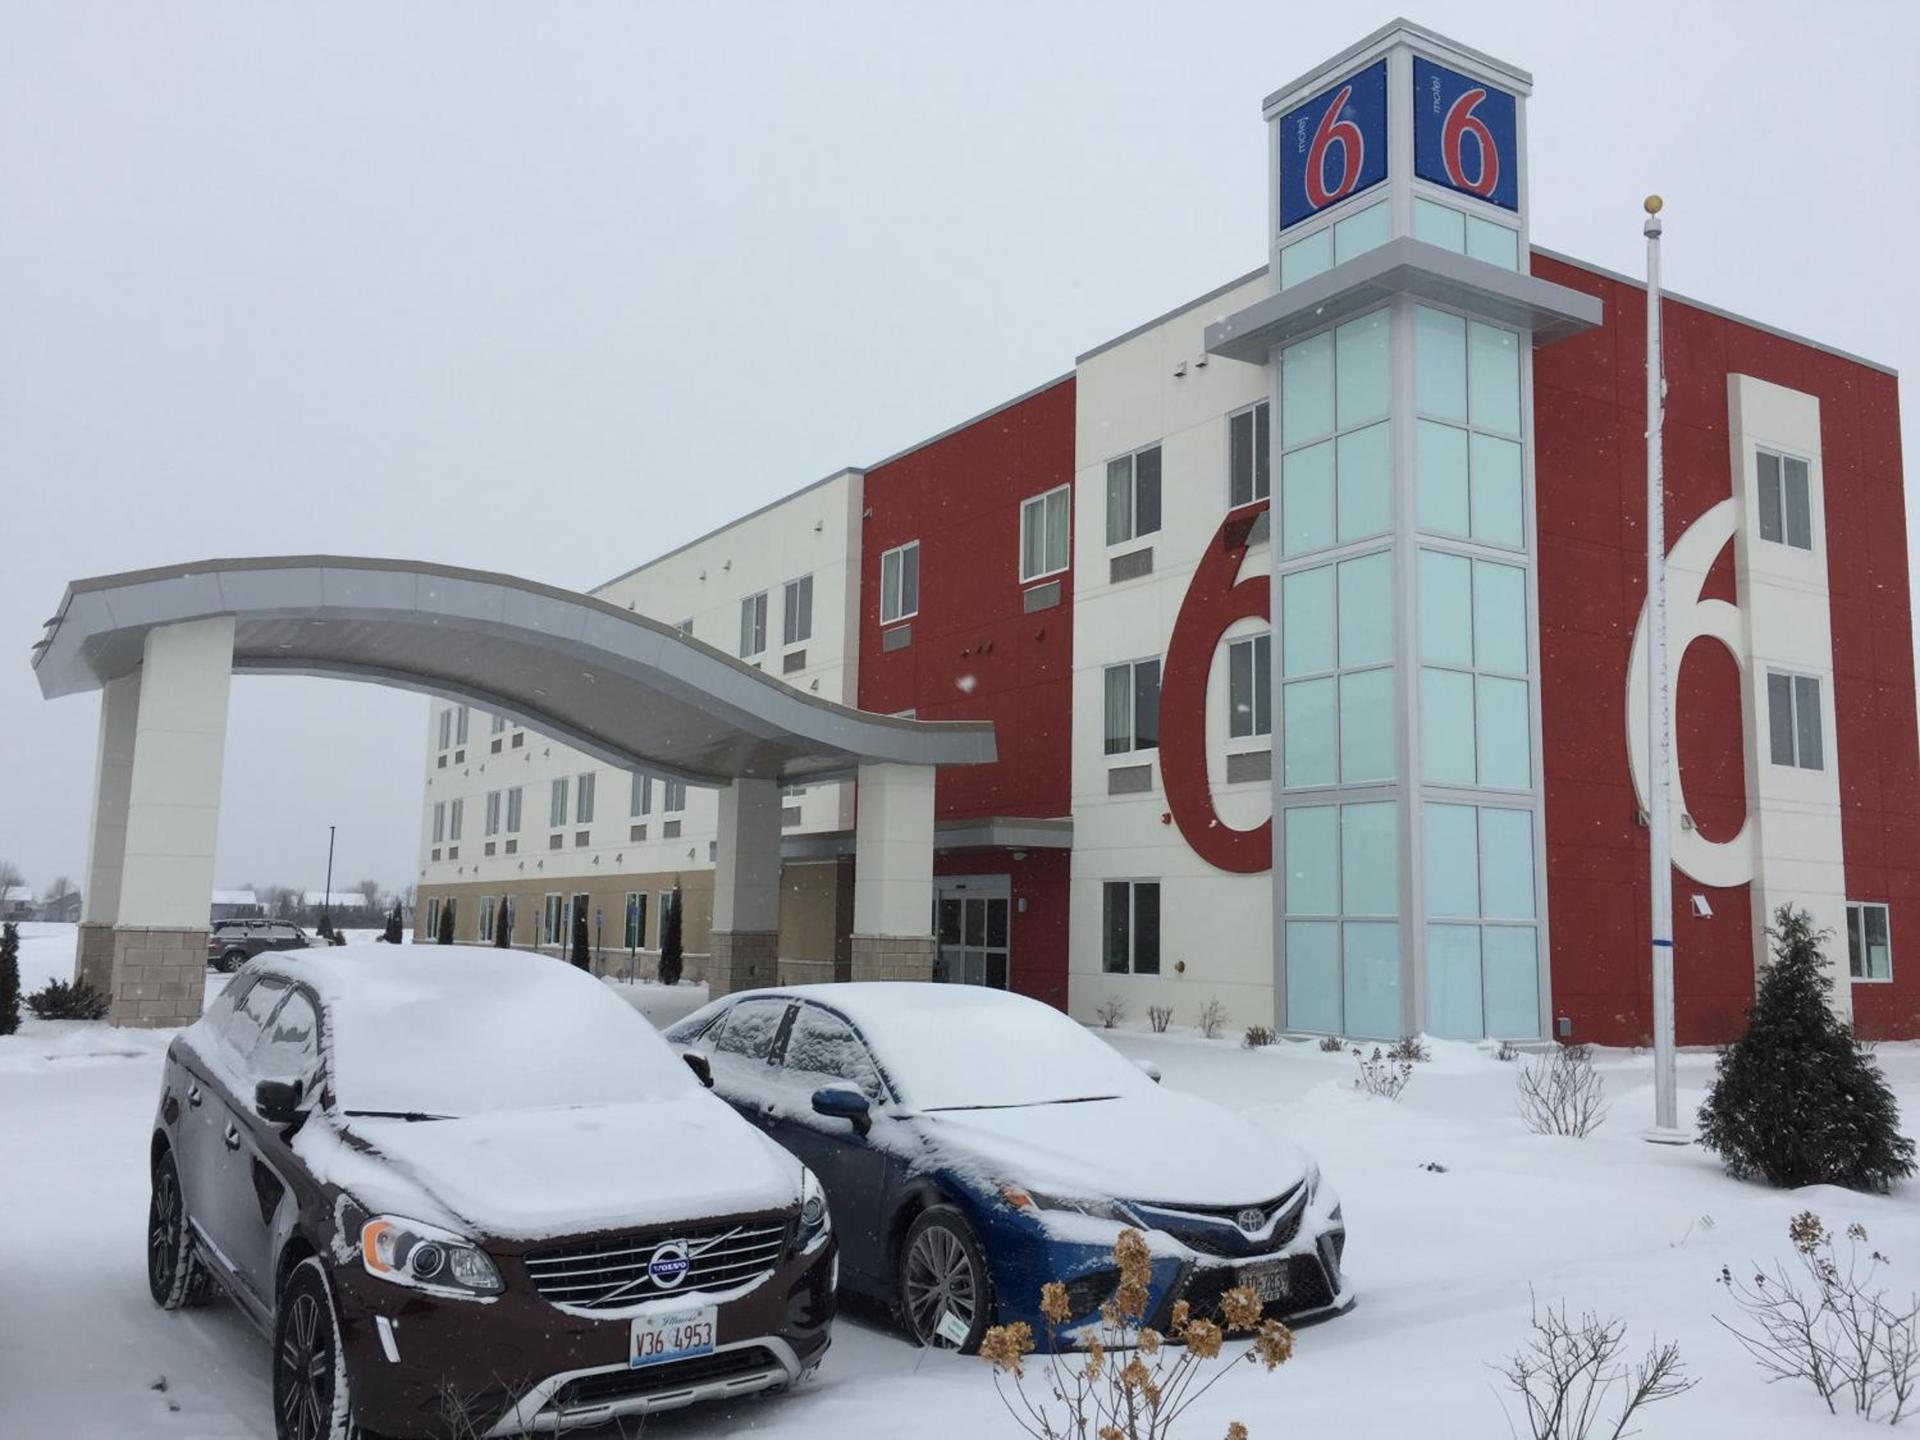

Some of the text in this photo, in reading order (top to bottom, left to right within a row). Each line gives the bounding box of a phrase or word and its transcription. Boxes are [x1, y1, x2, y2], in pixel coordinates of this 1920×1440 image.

[1431, 75, 1441, 114] motel
[1297, 117, 1309, 154] motel
[1305, 85, 1364, 209] 6
[1441, 88, 1499, 197] 6
[653, 1261, 686, 1273] VOLVO
[636, 1323, 712, 1357] V36 4953
